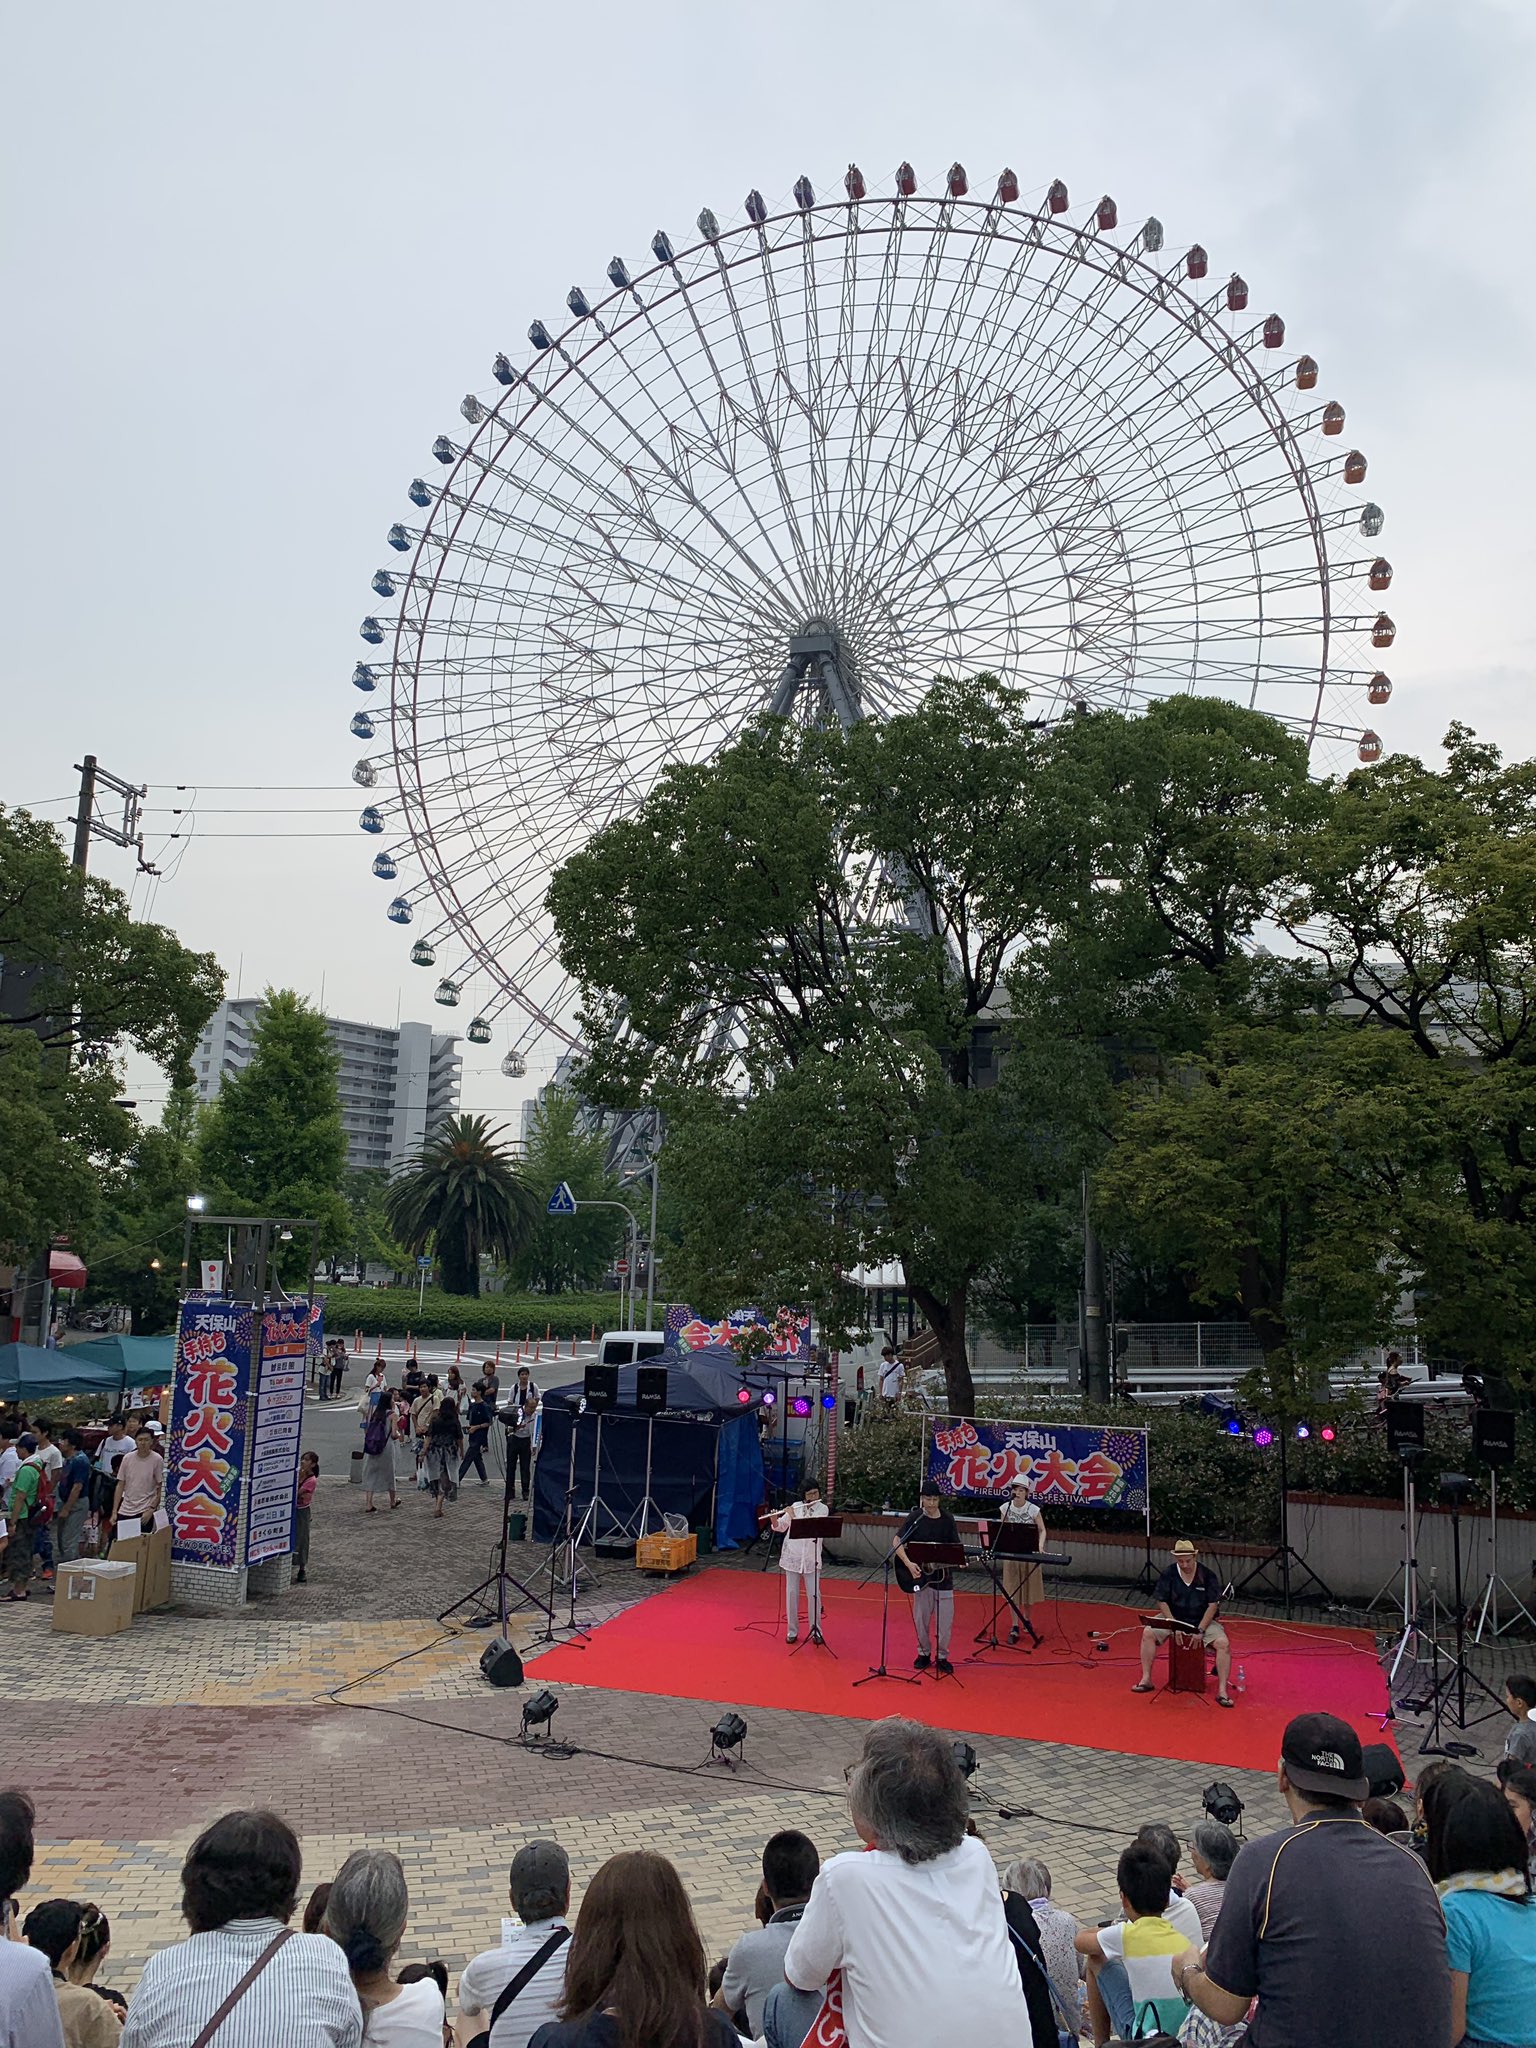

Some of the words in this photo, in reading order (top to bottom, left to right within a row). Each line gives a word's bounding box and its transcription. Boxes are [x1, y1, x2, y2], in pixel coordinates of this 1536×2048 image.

[195, 1314, 237, 1333] 天保山
[183, 1331, 226, 1363] 手持ち
[588, 1390, 608, 1398] RAMSA
[935, 1422, 978, 1453] 手持ち
[1394, 1430, 1418, 1438] RAMSA
[1005, 1431, 1057, 1451] 天保山
[1483, 1439, 1508, 1448] RAMSA
[174, 1357, 239, 1545] 花火大会
[946, 1441, 1123, 1501] 花火大会
[974, 1487, 1010, 1497] FIREWO
[174, 1539, 213, 1552] REWORKS
[1311, 1753, 1334, 1763] NORTH
[1317, 1760, 1333, 1768] FACE
